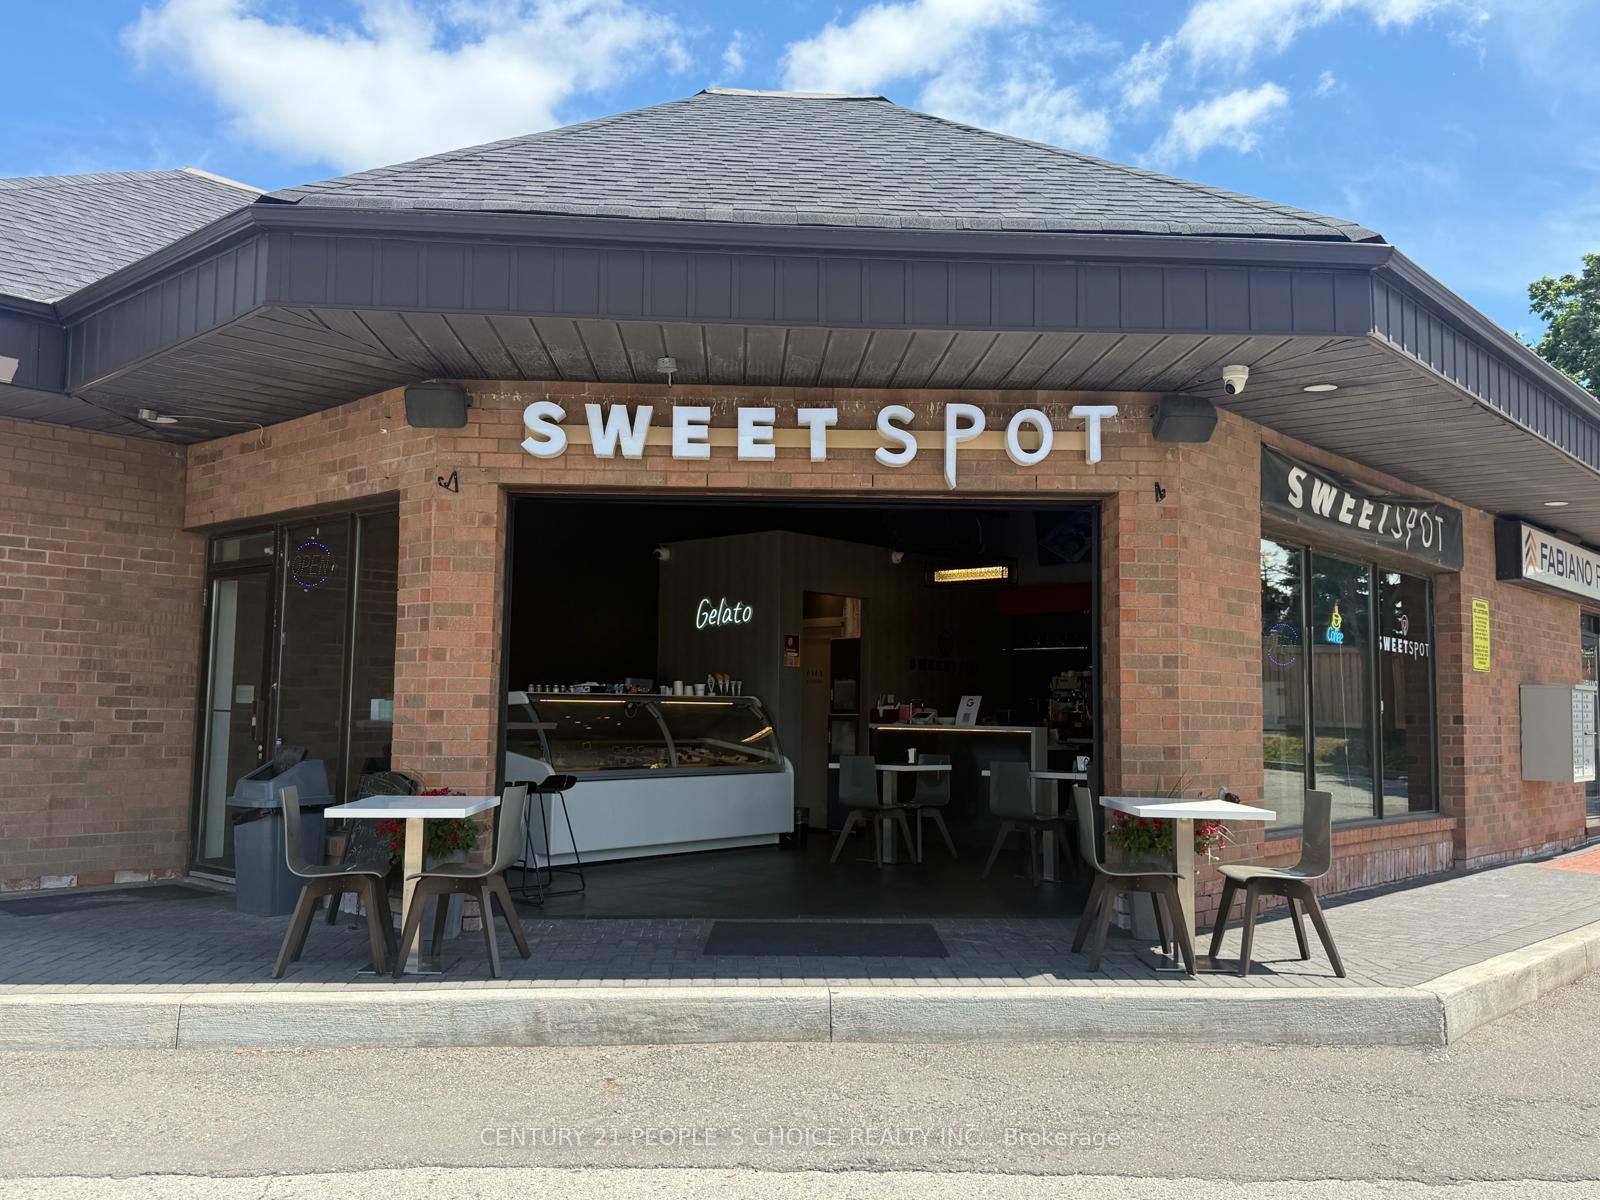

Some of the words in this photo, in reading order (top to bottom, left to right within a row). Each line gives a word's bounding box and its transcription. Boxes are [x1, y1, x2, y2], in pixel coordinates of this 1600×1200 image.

[521, 401, 838, 460] SWEET
[874, 403, 1119, 490] SPOT
[1540, 542, 1592, 587] FABIANO
[695, 597, 753, 630] Gelato
